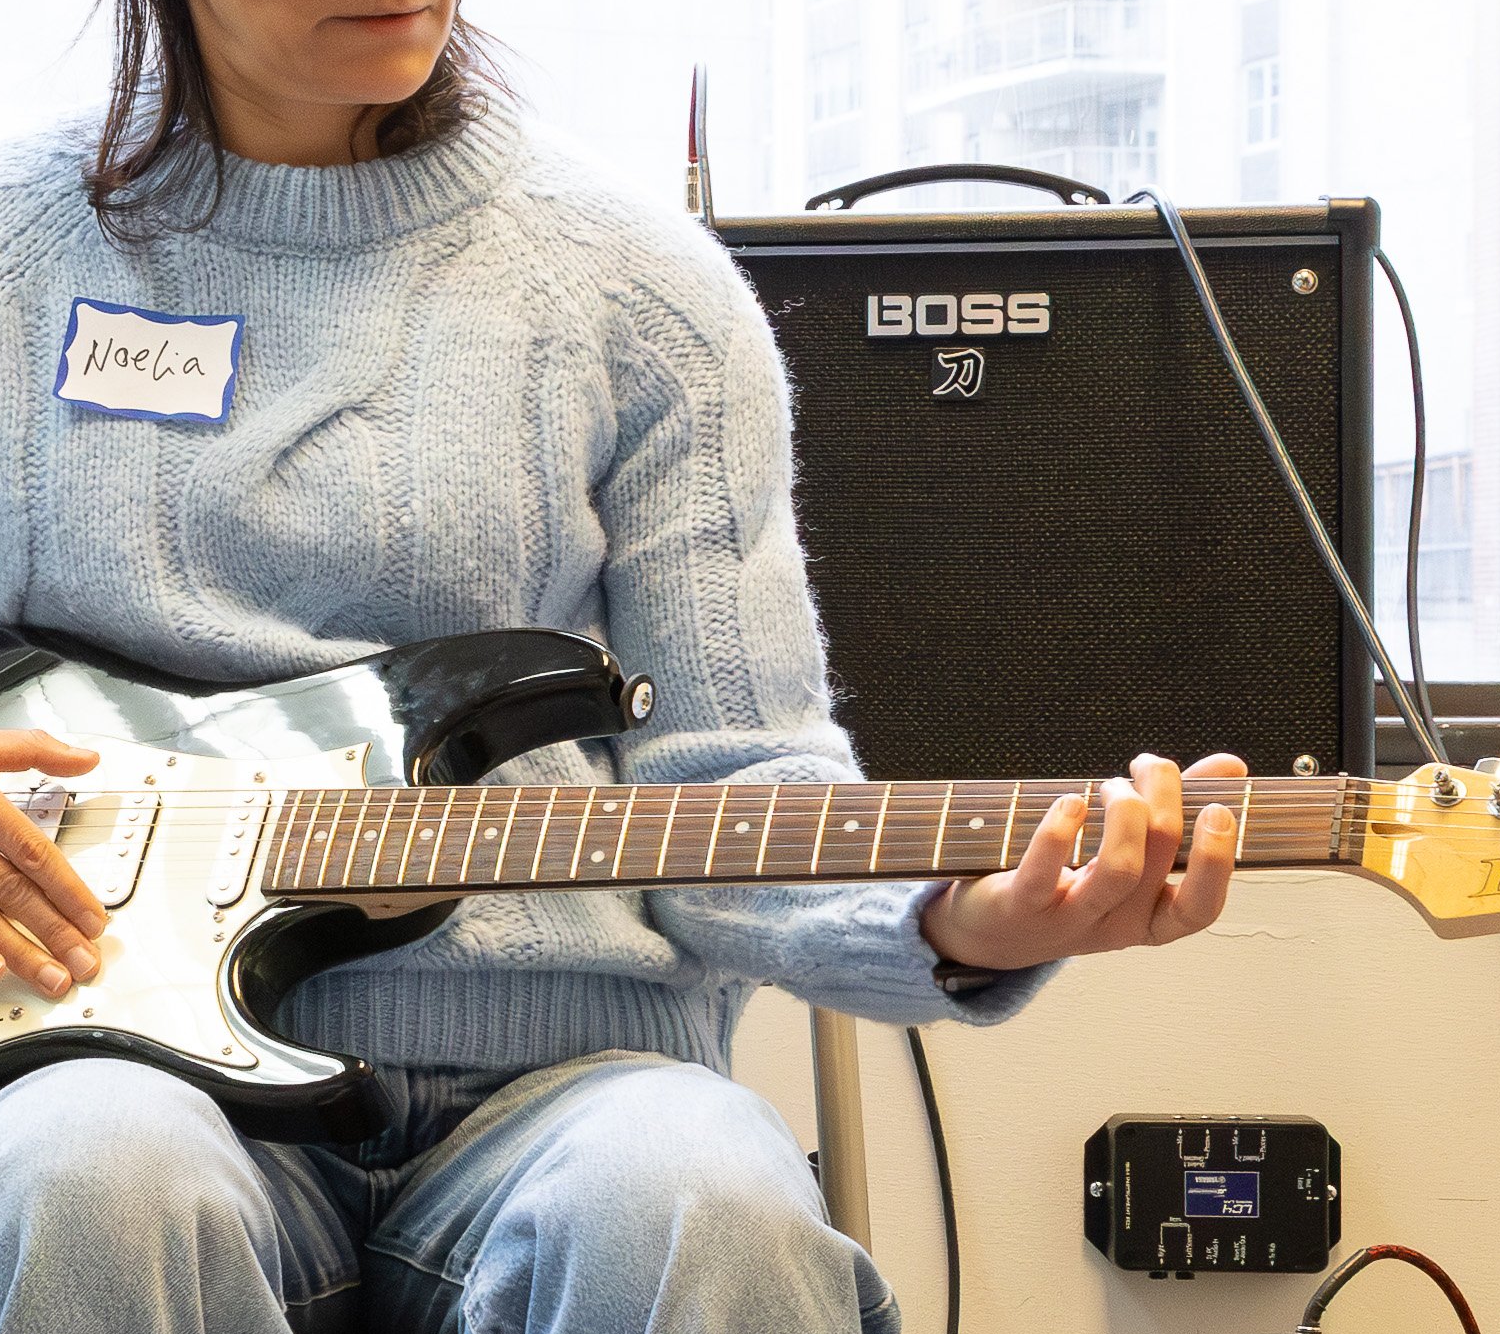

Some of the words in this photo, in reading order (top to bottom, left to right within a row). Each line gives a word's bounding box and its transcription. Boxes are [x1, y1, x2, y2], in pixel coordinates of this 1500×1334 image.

[867, 292, 1050, 336] BOSS
[83, 338, 205, 381] Noelia
[1222, 1204, 1253, 1214] LC4
